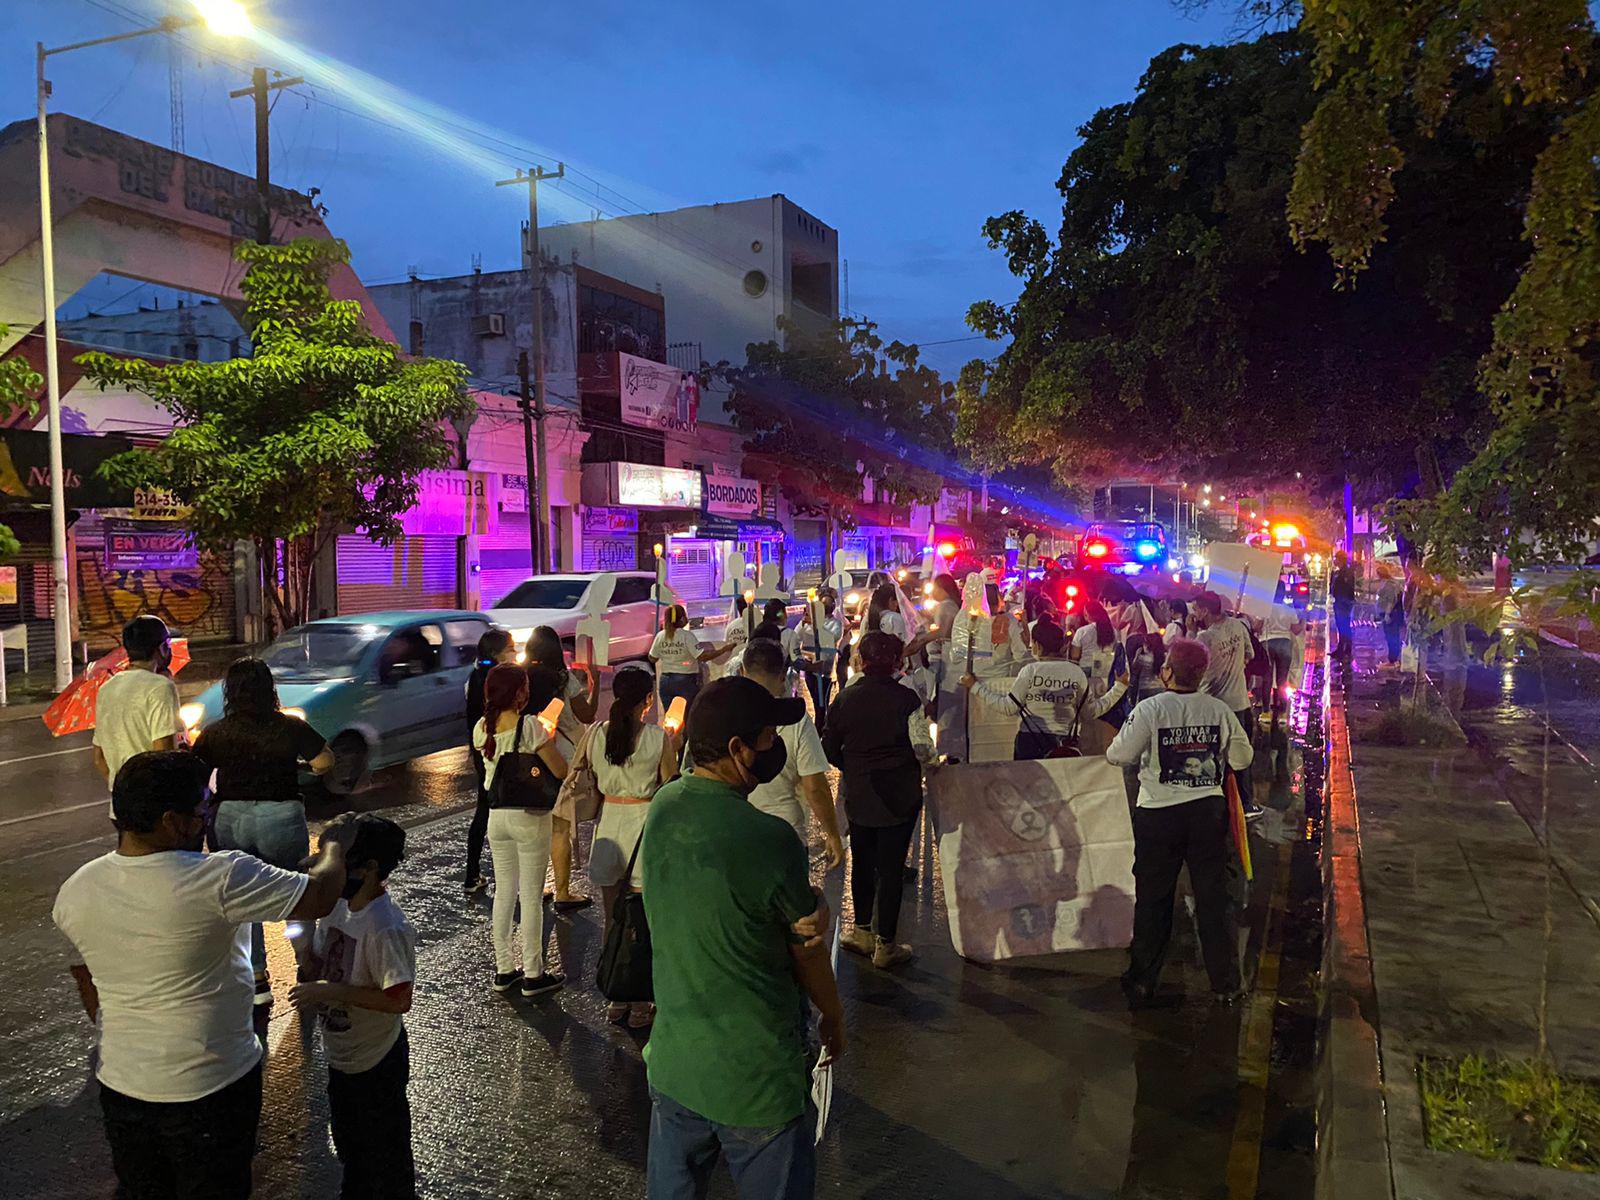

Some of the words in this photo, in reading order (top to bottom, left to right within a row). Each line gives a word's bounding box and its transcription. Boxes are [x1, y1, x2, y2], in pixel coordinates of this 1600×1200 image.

[27, 465, 82, 488] Nls
[709, 483, 758, 505] BORDADOS
[113, 536, 135, 550] EN
[1028, 675, 1080, 690] ¿Dónde
